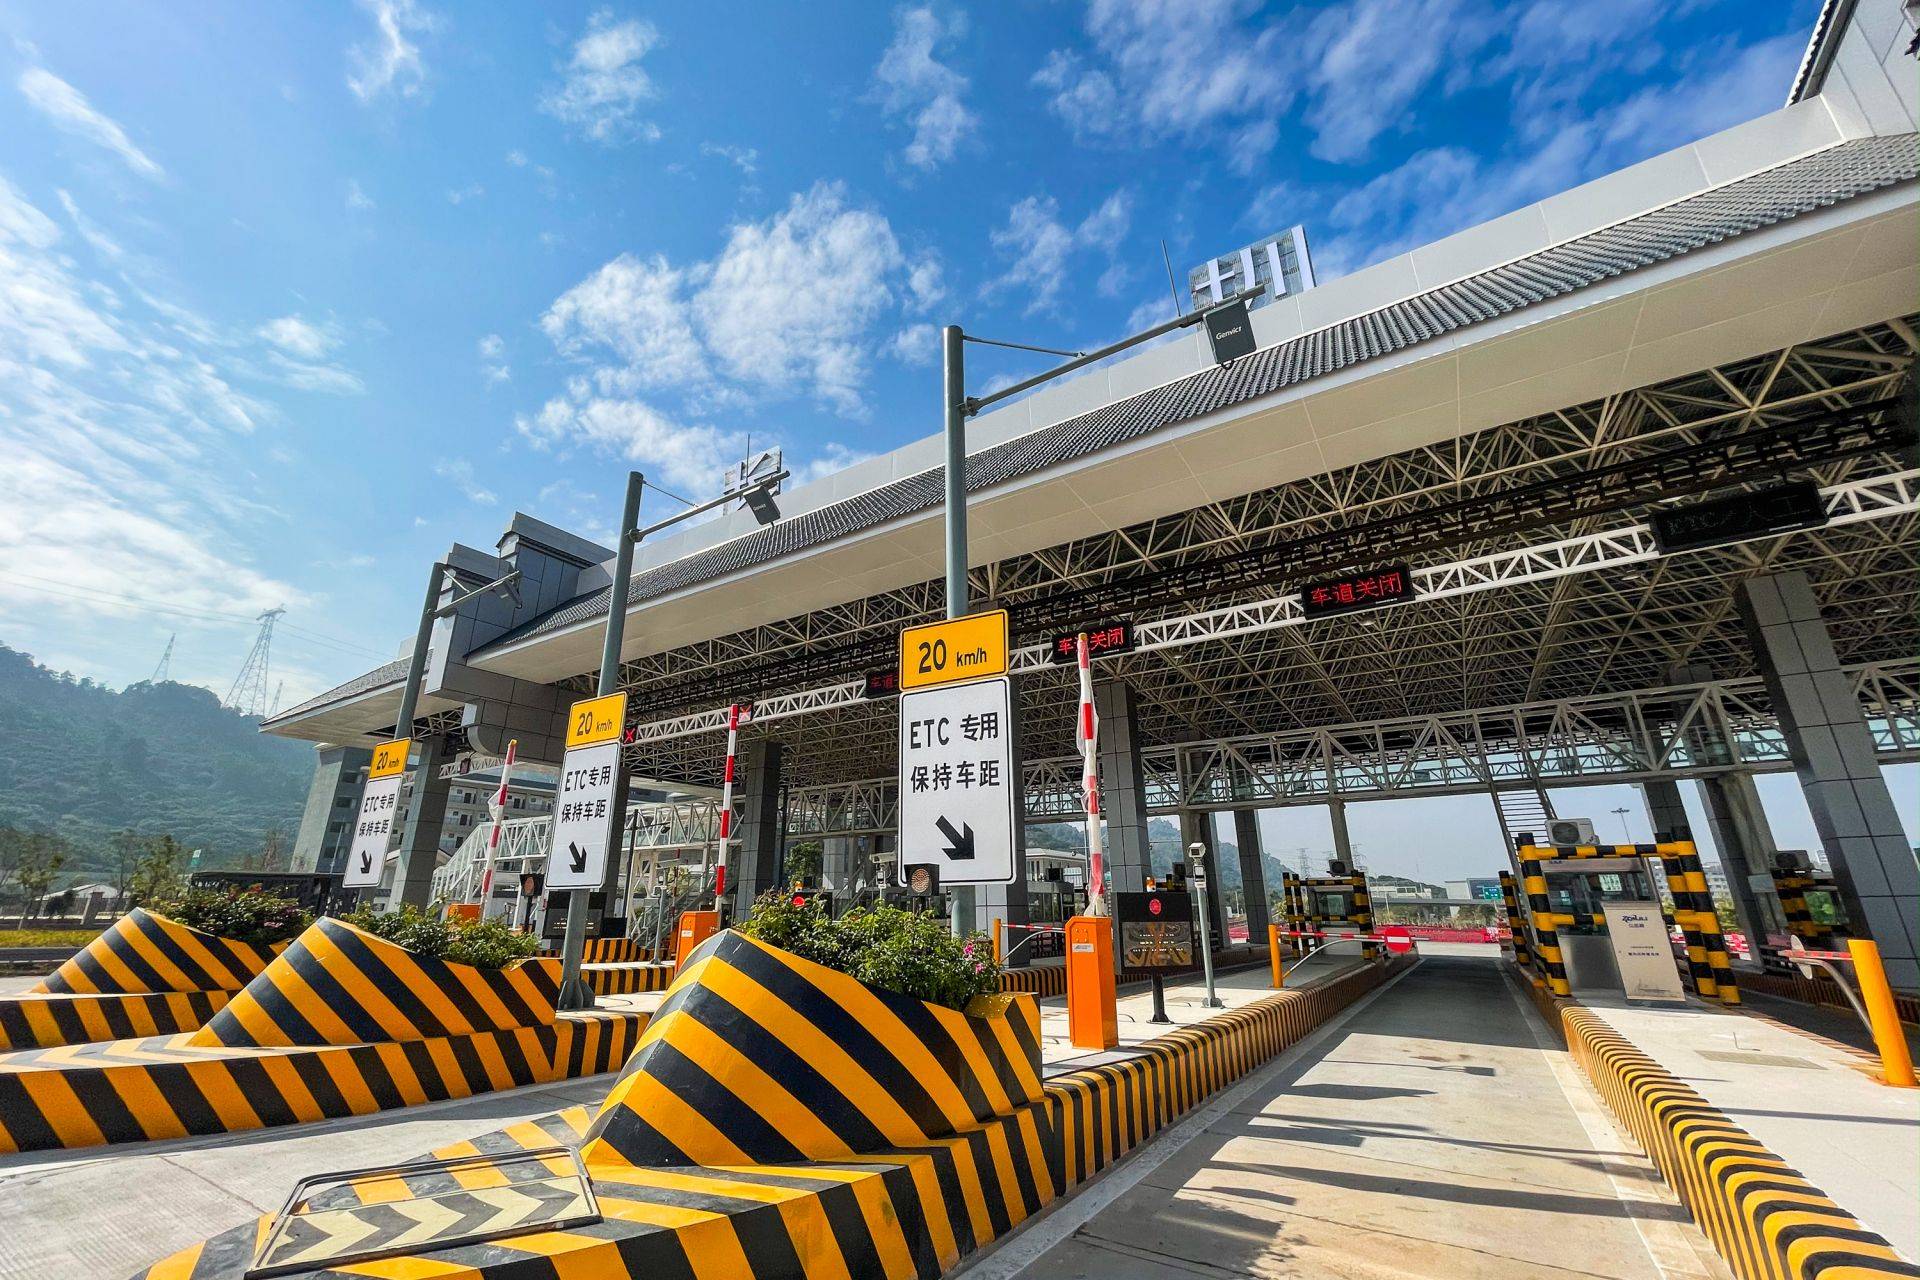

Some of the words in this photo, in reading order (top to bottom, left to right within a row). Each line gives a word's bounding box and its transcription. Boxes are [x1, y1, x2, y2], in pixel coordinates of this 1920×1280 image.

[1310, 572, 1402, 607] 车道关闭
[918, 639, 947, 673] 20
[956, 647, 988, 667] km/h
[576, 711, 593, 736] 20
[595, 719, 612, 732] km/h
[910, 717, 950, 749] ETC
[960, 712, 999, 742] 专用
[376, 751, 389, 771] 20
[564, 769, 587, 792] ETC
[588, 766, 611, 787] 专用
[911, 760, 1000, 793] 保持车距
[363, 796, 380, 813] ETC
[380, 793, 395, 810] 专用
[561, 799, 606, 824] 保持车距
[358, 819, 390, 838] 保持车距
